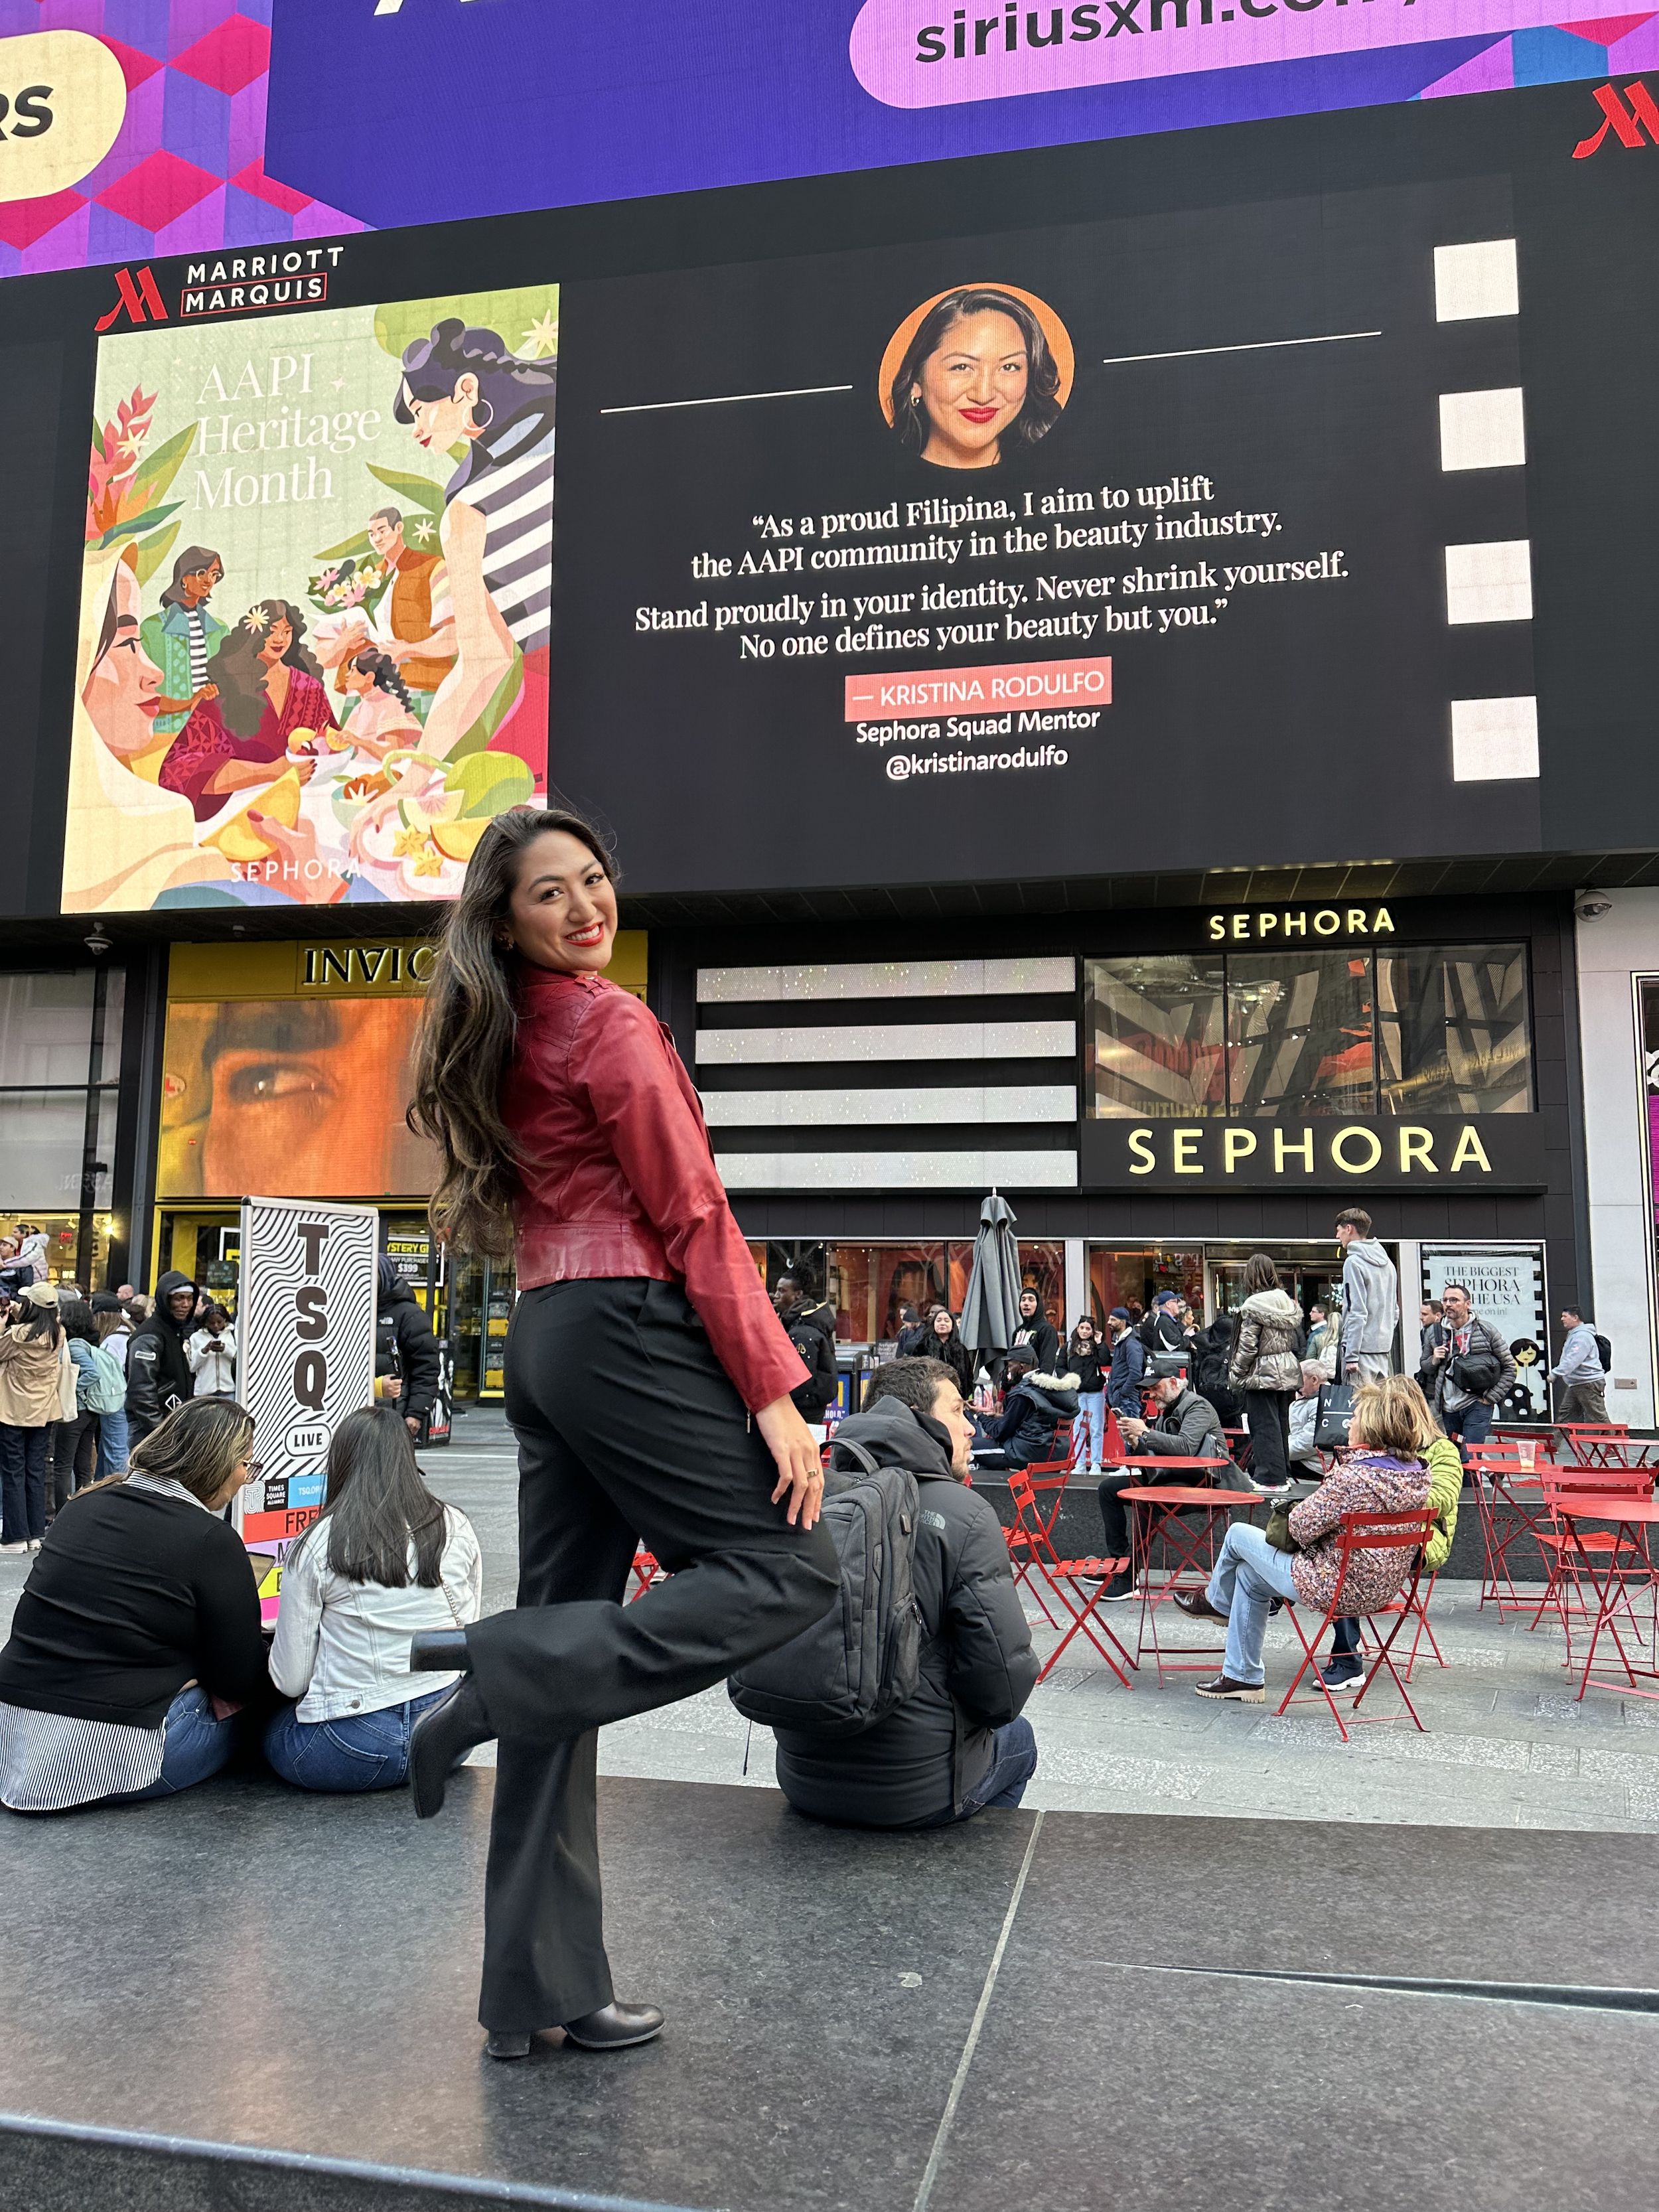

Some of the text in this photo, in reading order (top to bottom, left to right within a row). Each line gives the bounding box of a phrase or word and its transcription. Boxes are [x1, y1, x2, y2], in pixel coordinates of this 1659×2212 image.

[186, 247, 344, 285] MARRIOTT
[185, 278, 323, 314] MARQUIS
[195, 353, 316, 405] AAPI
[194, 405, 382, 457] Heritage
[191, 456, 334, 512] Month
[800, 517, 816, 536] a
[822, 502, 899, 538] proud
[906, 496, 1017, 529] Filipina,
[1023, 492, 1034, 516] I
[1041, 488, 1094, 514] aim
[1100, 486, 1129, 510] to
[1135, 475, 1214, 510] uplift
[691, 510, 1283, 579] the AAPI community in the beauty industry.
[634, 551, 1349, 631] Stand proudly in your identity. Never shrink yourself.
[739, 634, 775, 659] No
[782, 634, 828, 655] one
[835, 624, 930, 653] defines
[936, 621, 999, 650] your
[1005, 610, 1099, 641] beauty
[1106, 605, 1153, 633] but
[881, 681, 985, 706] KRISTINA
[991, 670, 1105, 699] RODULFO
[856, 710, 1102, 747] Sephora Squad Mentor
[886, 744, 1068, 780] @kristinarodulfo
[230, 861, 362, 883] SEPHORA
[1209, 907, 1397, 940] SEPHORA
[302, 946, 439, 986] INVIC
[1128, 1125, 1492, 1174] SEPHORA
[388, 1242, 429, 1254] YSTERY GI
[397, 1263, 419, 1273] $399
[1444, 1266, 1519, 1276] THE BIGGEST
[293, 1222, 330, 1412] TSQ
[1471, 1293, 1521, 1305] HE USA
[293, 1432, 323, 1447] LIVE
[266, 1491, 286, 1500] SQUARE
[285, 1509, 323, 1534] FRE
[920, 1513, 935, 1522] RTH
